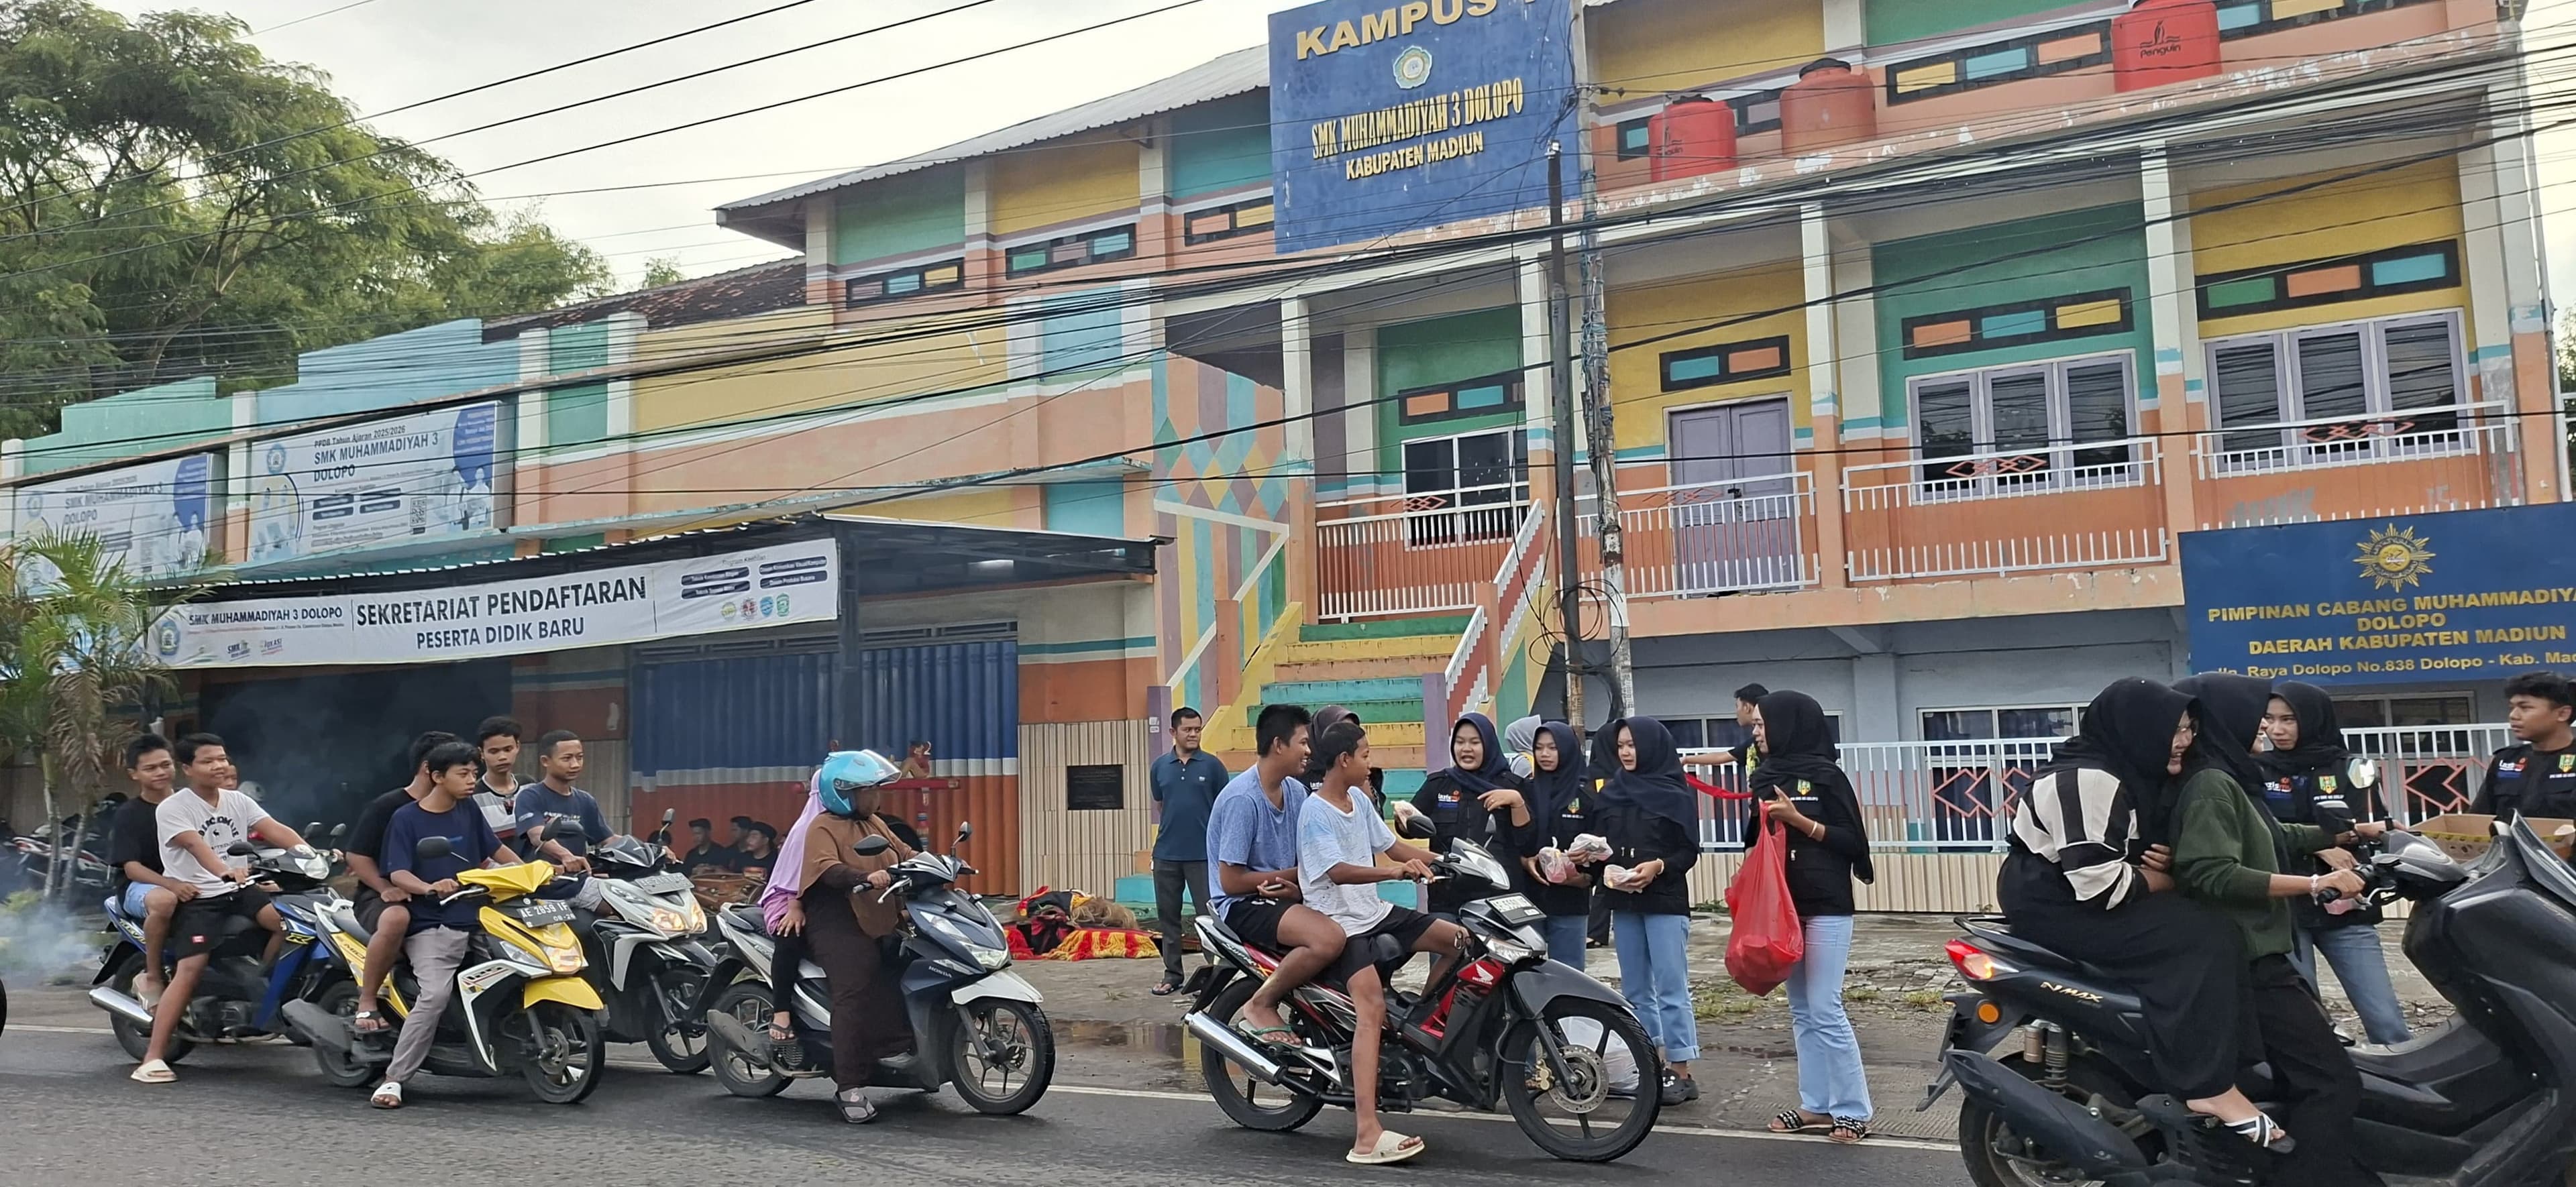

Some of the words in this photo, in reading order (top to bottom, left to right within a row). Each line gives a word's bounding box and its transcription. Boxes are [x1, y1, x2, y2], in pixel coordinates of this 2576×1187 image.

[2140, 44, 2181, 59] Penguin
[1311, 120, 1339, 159] SMK
[1340, 95, 1448, 153] MUHAMMADIYAH
[1452, 92, 1461, 127] 3
[1464, 77, 1524, 125] DOLOPO
[1345, 144, 1424, 180] KABUPATEN
[1427, 131, 1484, 163] MADIUN
[332, 435, 351, 446] Tahun
[373, 425, 407, 438] 2025/2026
[314, 449, 336, 465] SMK
[339, 436, 429, 461] MUHAMMADIYAH
[431, 433, 439, 446] 3
[314, 464, 356, 482] DOLOPO
[356, 595, 480, 626] SEKRETARIAT
[488, 575, 647, 616] PENDAFTARAN
[2208, 604, 2310, 622] PIMPINAN
[2317, 598, 2408, 617] CABANG
[2414, 587, 2576, 611] MUHAMMADIYA
[189, 613, 209, 626] SMK
[211, 608, 290, 624] MUHAMMADIYAH
[292, 608, 299, 620] 3
[301, 606, 343, 620] DOLOPO
[2356, 613, 2446, 632] DOLOPO
[416, 626, 481, 650] PESERTA
[485, 622, 533, 644] DIDIK
[538, 617, 585, 639] BARU
[2248, 637, 2332, 655] DAERAH
[2339, 630, 2468, 651] KABUPATEN
[2475, 625, 2566, 644] MADIUN
[2247, 665, 2288, 679] Raya
[2292, 660, 2351, 677] Dolopo
[2357, 659, 2415, 673] No.838
[2420, 655, 2482, 671] Dolopo
[2499, 653, 2540, 665] Kab.
[520, 908, 533, 918] AE
[557, 902, 569, 911] IF
[928, 965, 953, 978] HONDA
